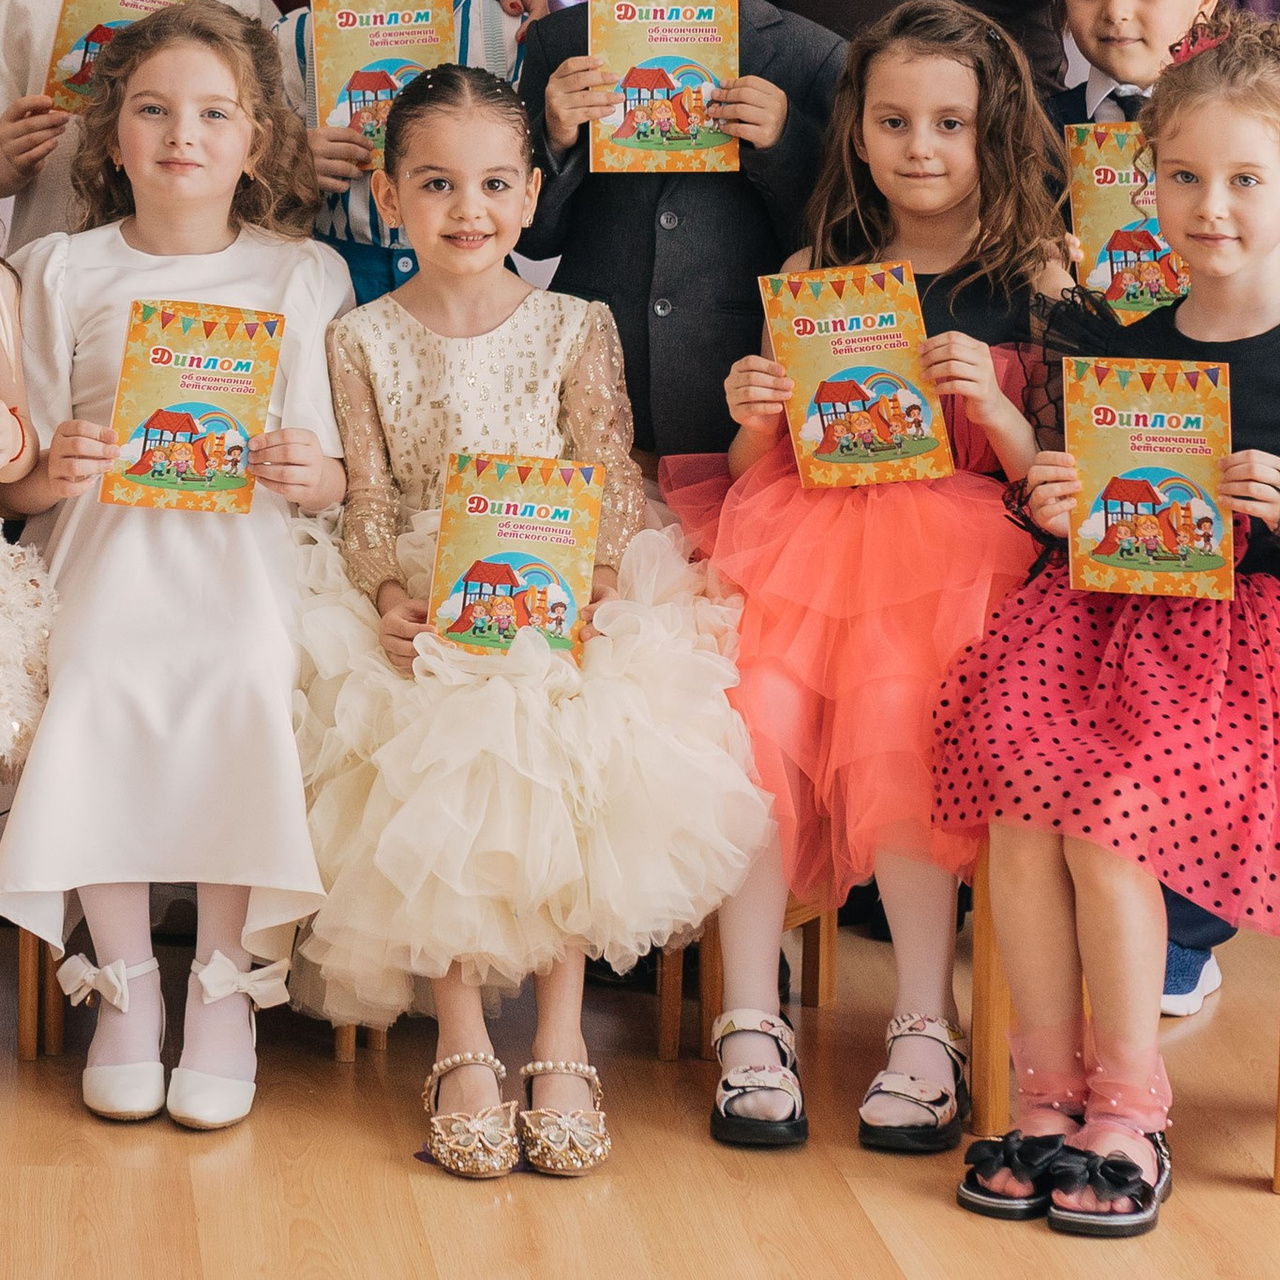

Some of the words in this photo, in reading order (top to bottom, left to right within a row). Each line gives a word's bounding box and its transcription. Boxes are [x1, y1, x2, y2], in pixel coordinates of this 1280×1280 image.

[337, 10, 431, 28] Диплом
[616, 2, 713, 21] Диплом
[648, 26, 659, 34] об
[648, 34, 695, 43] детского
[698, 34, 721, 43] сада
[793, 313, 896, 336] Диплом
[831, 337, 843, 346] об
[845, 332, 902, 345] окончании
[832, 343, 882, 355] детского
[884, 340, 909, 349] сада
[151, 347, 252, 372] Диплом
[181, 373, 194, 381] об
[196, 374, 252, 386] окончании
[180, 381, 229, 392] детского
[231, 386, 255, 394] сада
[1093, 406, 1202, 430] Диплом
[1130, 433, 1143, 442] об
[1145, 435, 1206, 445] окончании
[1130, 442, 1183, 453] детского
[1185, 446, 1212, 455] сада
[467, 496, 570, 522] Диплом
[498, 521, 511, 529] об
[513, 523, 572, 536] окончании
[497, 529, 548, 542] детского
[550, 536, 576, 546] сада
